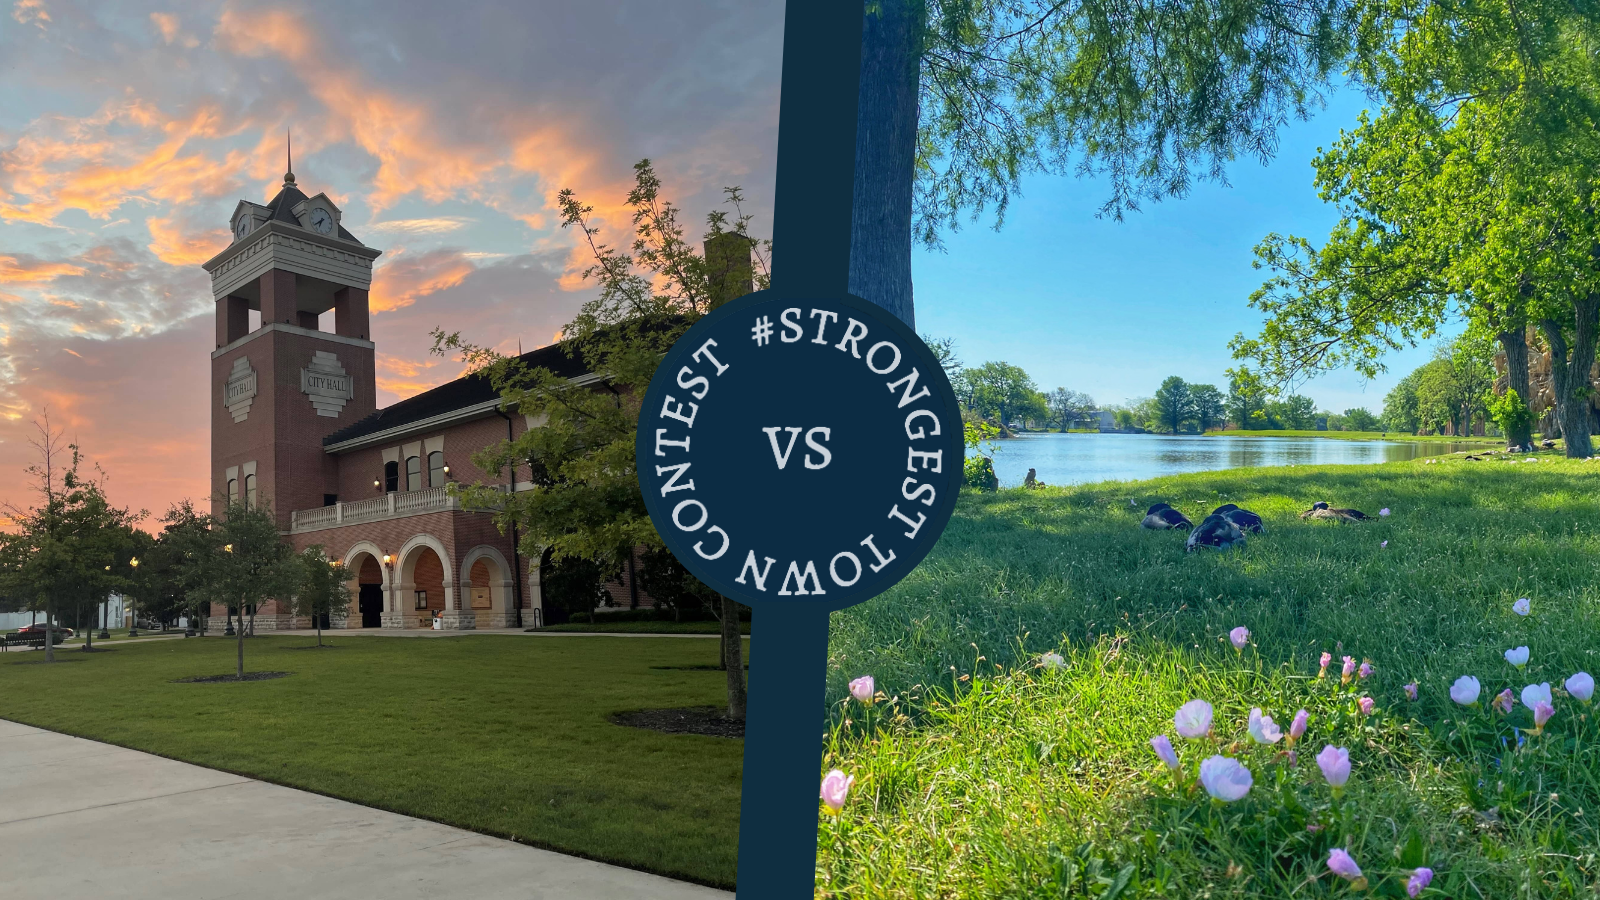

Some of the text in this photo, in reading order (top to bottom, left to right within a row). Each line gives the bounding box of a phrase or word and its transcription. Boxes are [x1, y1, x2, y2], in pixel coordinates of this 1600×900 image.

[229, 380, 252, 398] CITY HALL
[308, 376, 346, 392] CITY HALL
